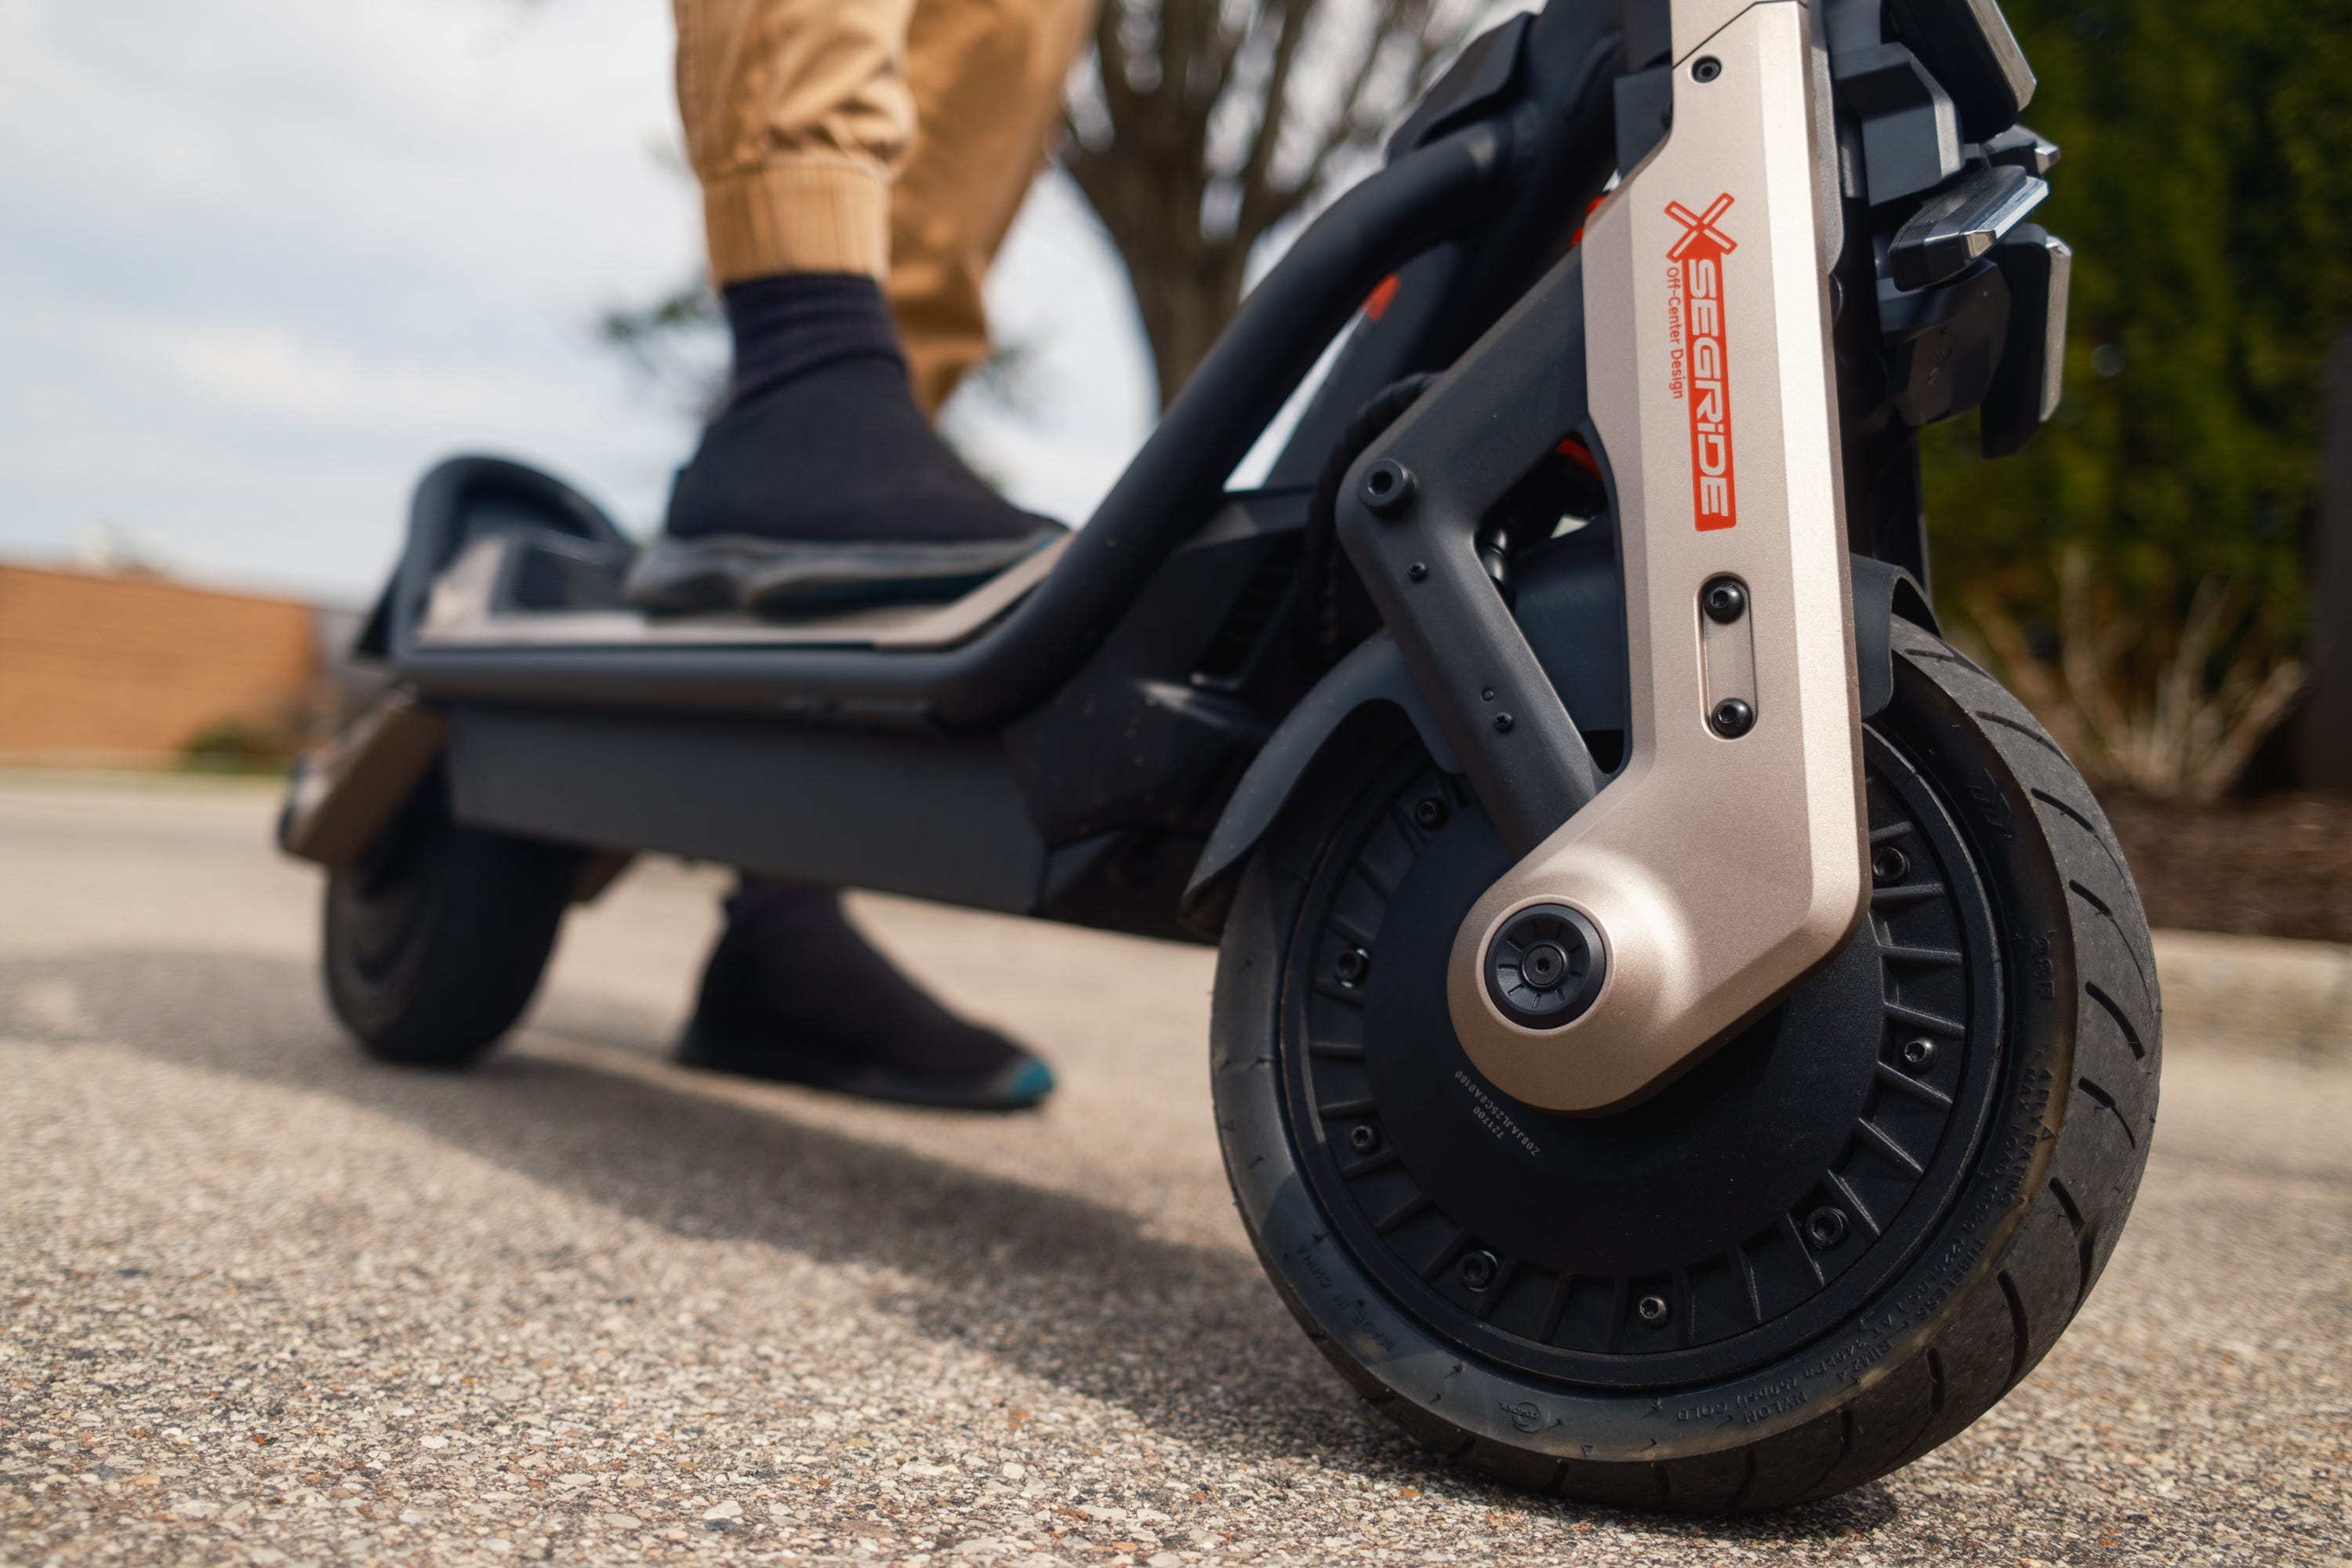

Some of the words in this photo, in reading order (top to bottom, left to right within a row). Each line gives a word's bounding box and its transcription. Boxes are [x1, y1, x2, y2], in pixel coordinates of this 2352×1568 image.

[1666, 267, 1682, 345] Off-Center
[1669, 348, 1686, 399] Design
[1473, 1105, 1504, 1139] 721700
[2027, 1087, 2051, 1127] PLY
[1993, 1124, 2023, 1177] LOAD
[1996, 1131, 2040, 1208] RATING
[1294, 1241, 1334, 1291] CHINA
[1911, 1234, 1989, 1324] TUBELESS
[1333, 1292, 1351, 1312] IN
[1351, 1311, 1396, 1354] MADE
[1870, 1312, 1896, 1337] AT
[1675, 1399, 1727, 1421] COLD
[1743, 1389, 1806, 1424] NYLON
